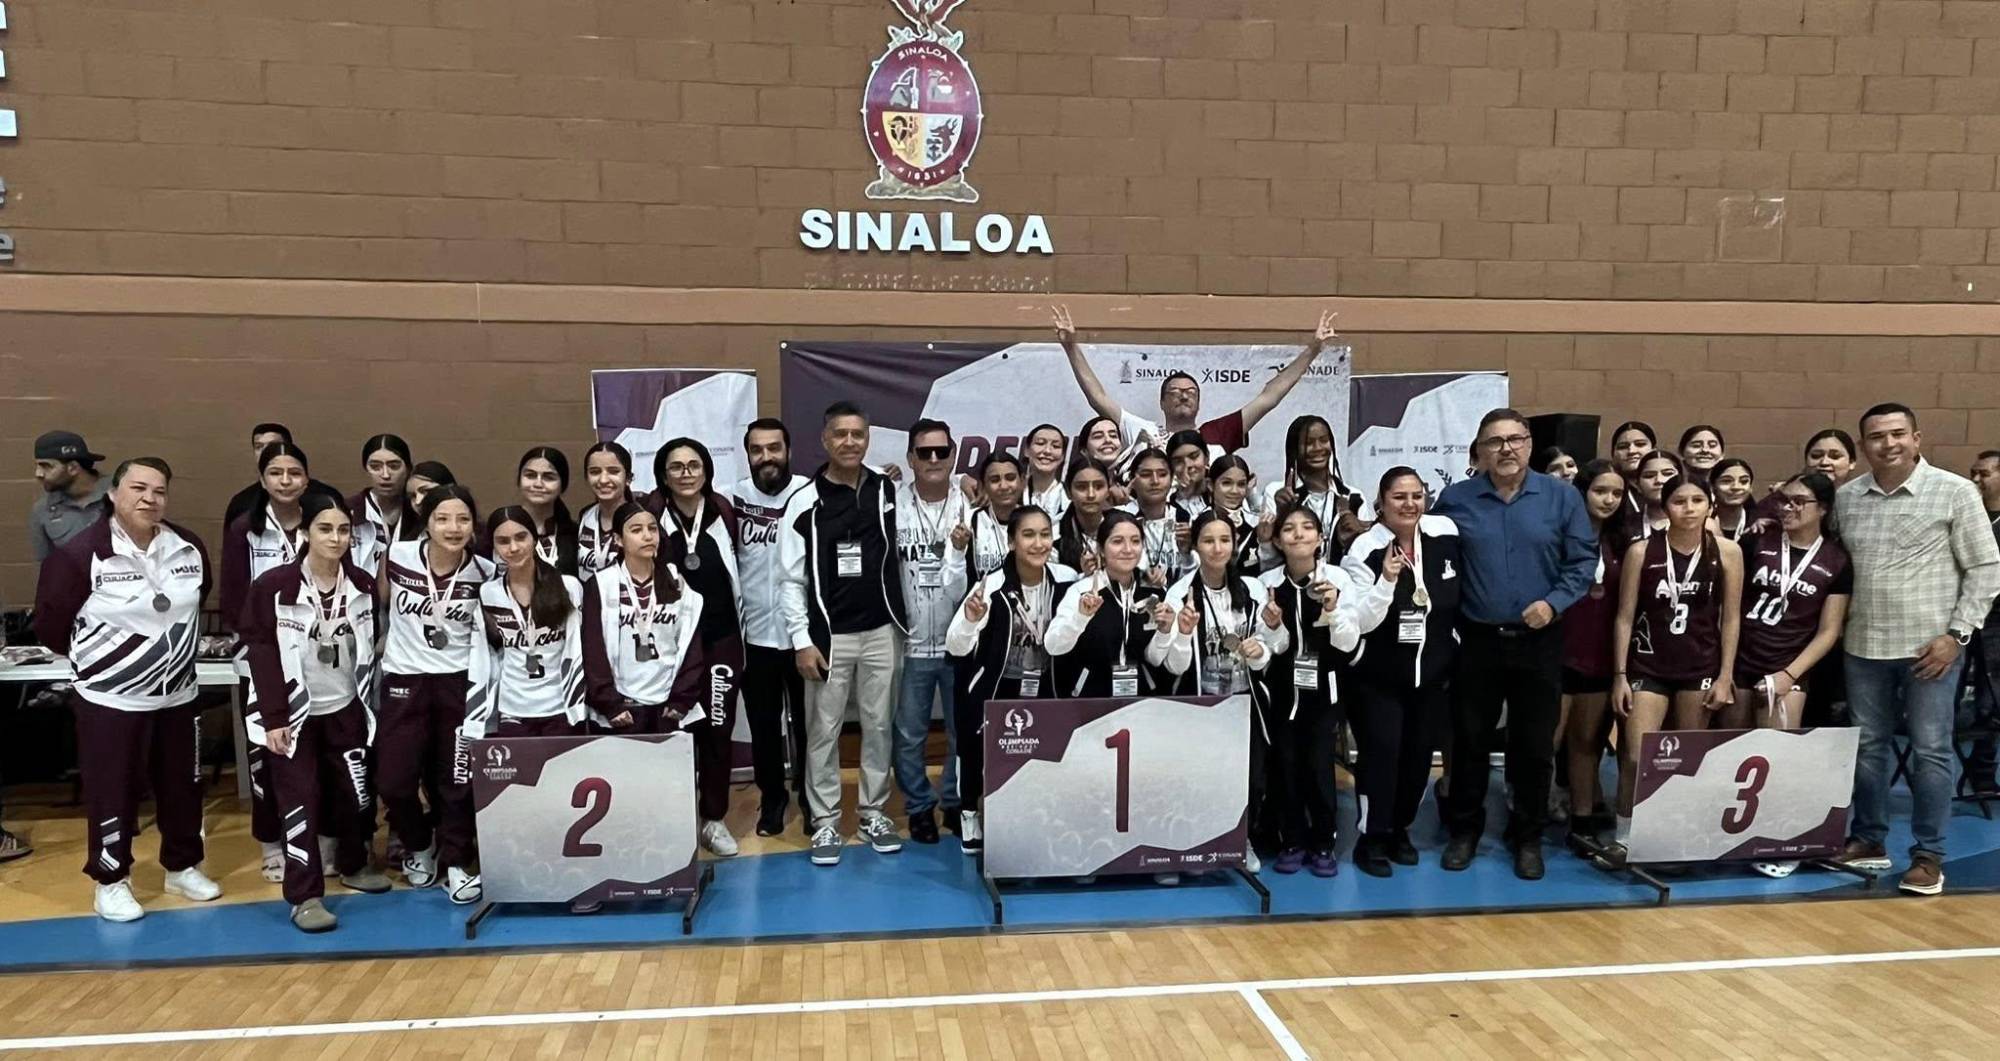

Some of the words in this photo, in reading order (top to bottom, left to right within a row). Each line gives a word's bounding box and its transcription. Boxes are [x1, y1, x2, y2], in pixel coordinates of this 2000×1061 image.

[898, 46, 948, 62] SINALOA
[799, 208, 1054, 254] SINALOA
[1135, 368, 1185, 378] SINALO
[1215, 369, 1251, 383] ISDE
[1306, 365, 1340, 376] NADE
[1669, 603, 1689, 635] 8
[1746, 592, 1789, 626] 10
[710, 664, 733, 727] Culiacán
[1701, 678, 1712, 691] 8
[1105, 728, 1131, 833] 1
[1721, 755, 1770, 834] 3
[562, 777, 612, 858] 2
